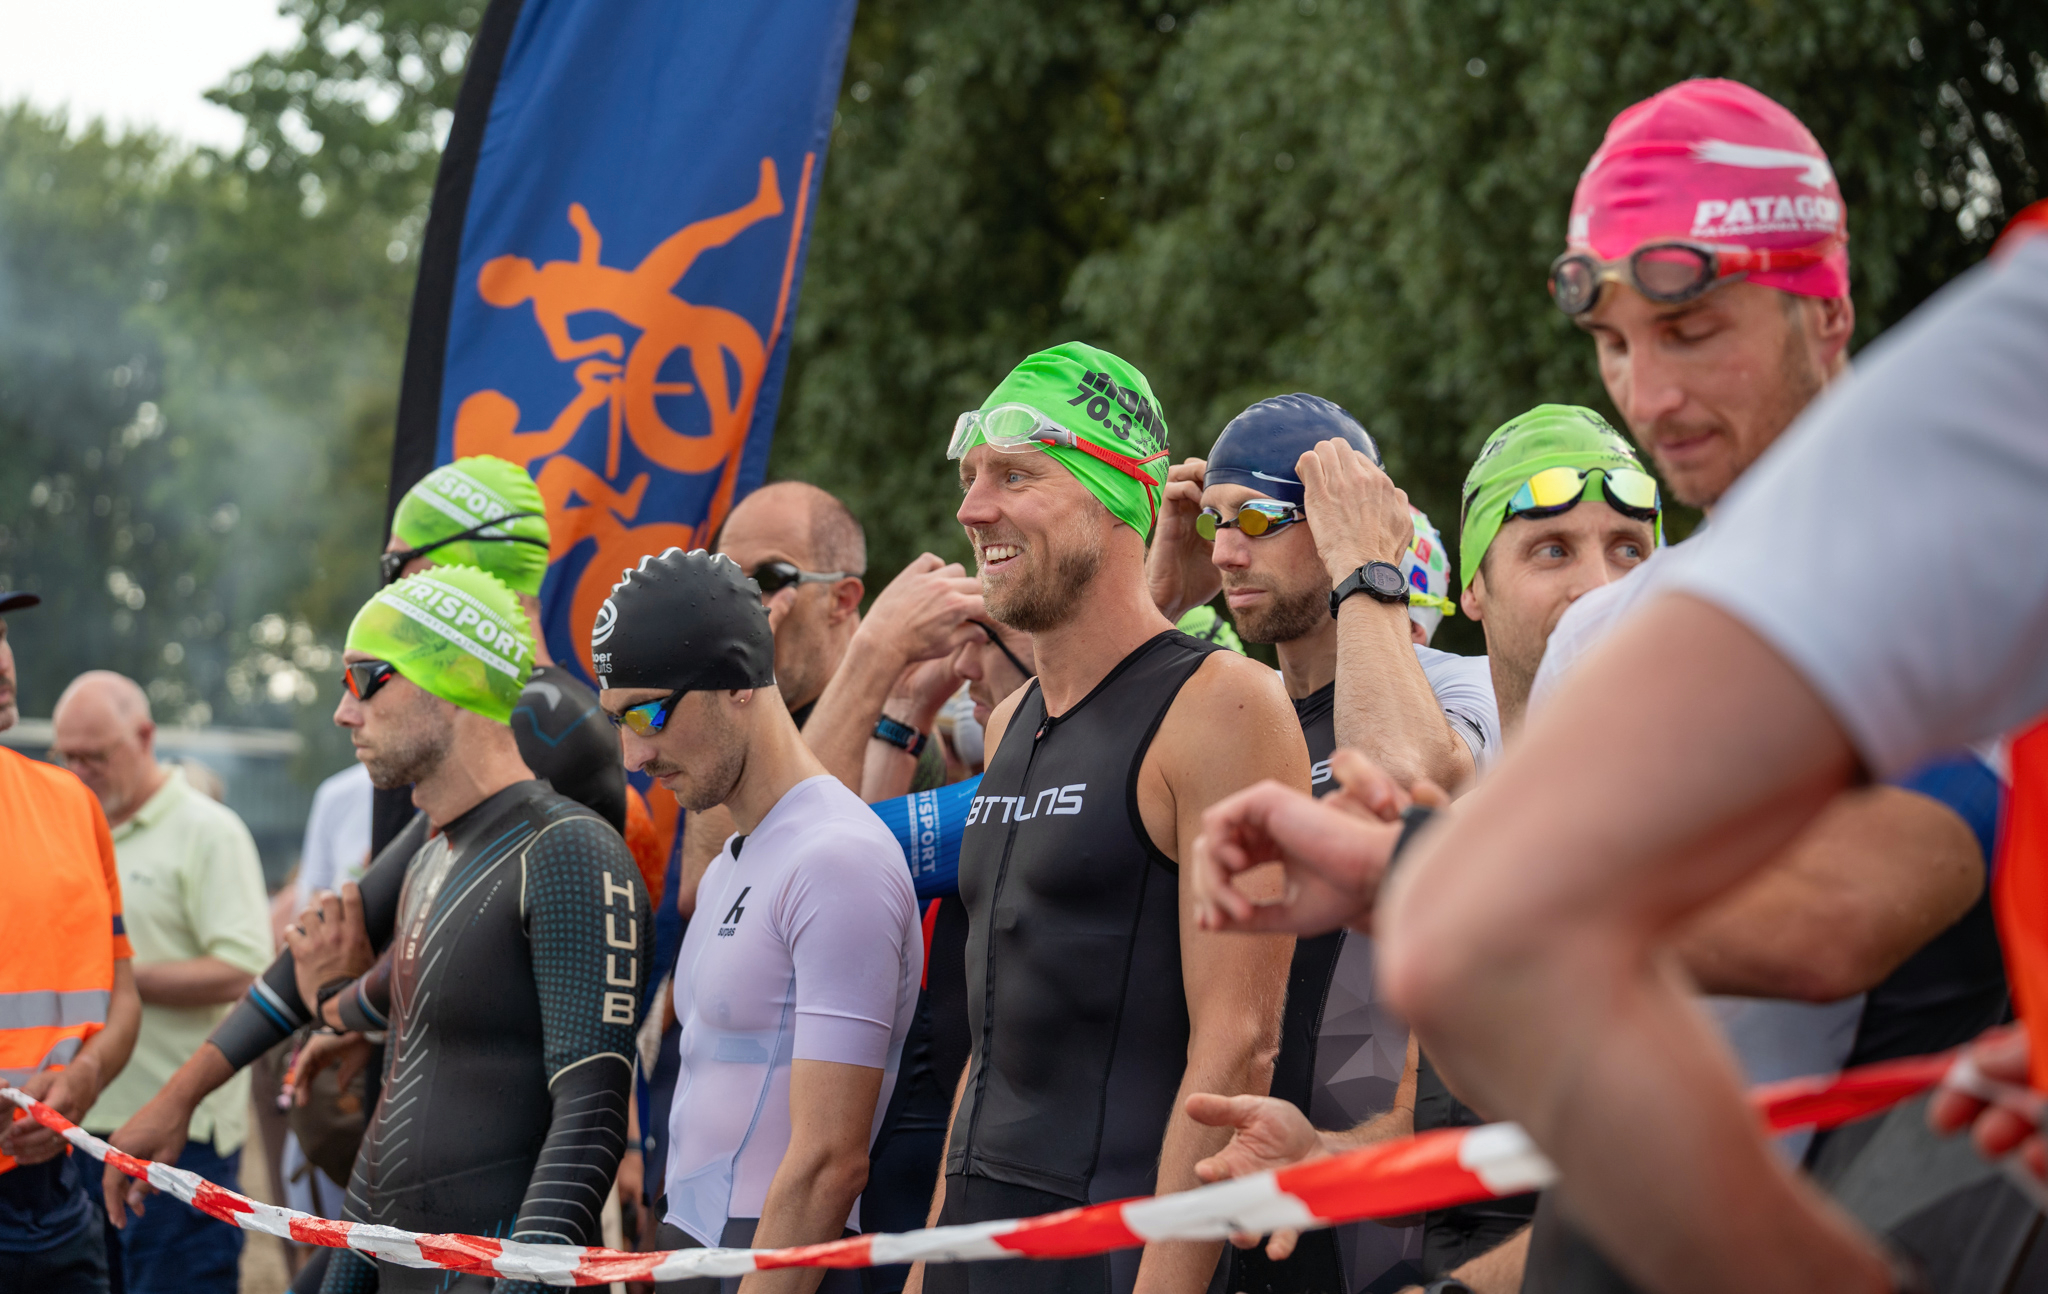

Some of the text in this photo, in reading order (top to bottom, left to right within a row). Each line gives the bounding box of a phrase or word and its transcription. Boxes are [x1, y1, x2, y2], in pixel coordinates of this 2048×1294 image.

[1066, 382, 1133, 441] 70.3
[398, 580, 529, 663] TRISPORT
[602, 870, 637, 1026] HUUB
